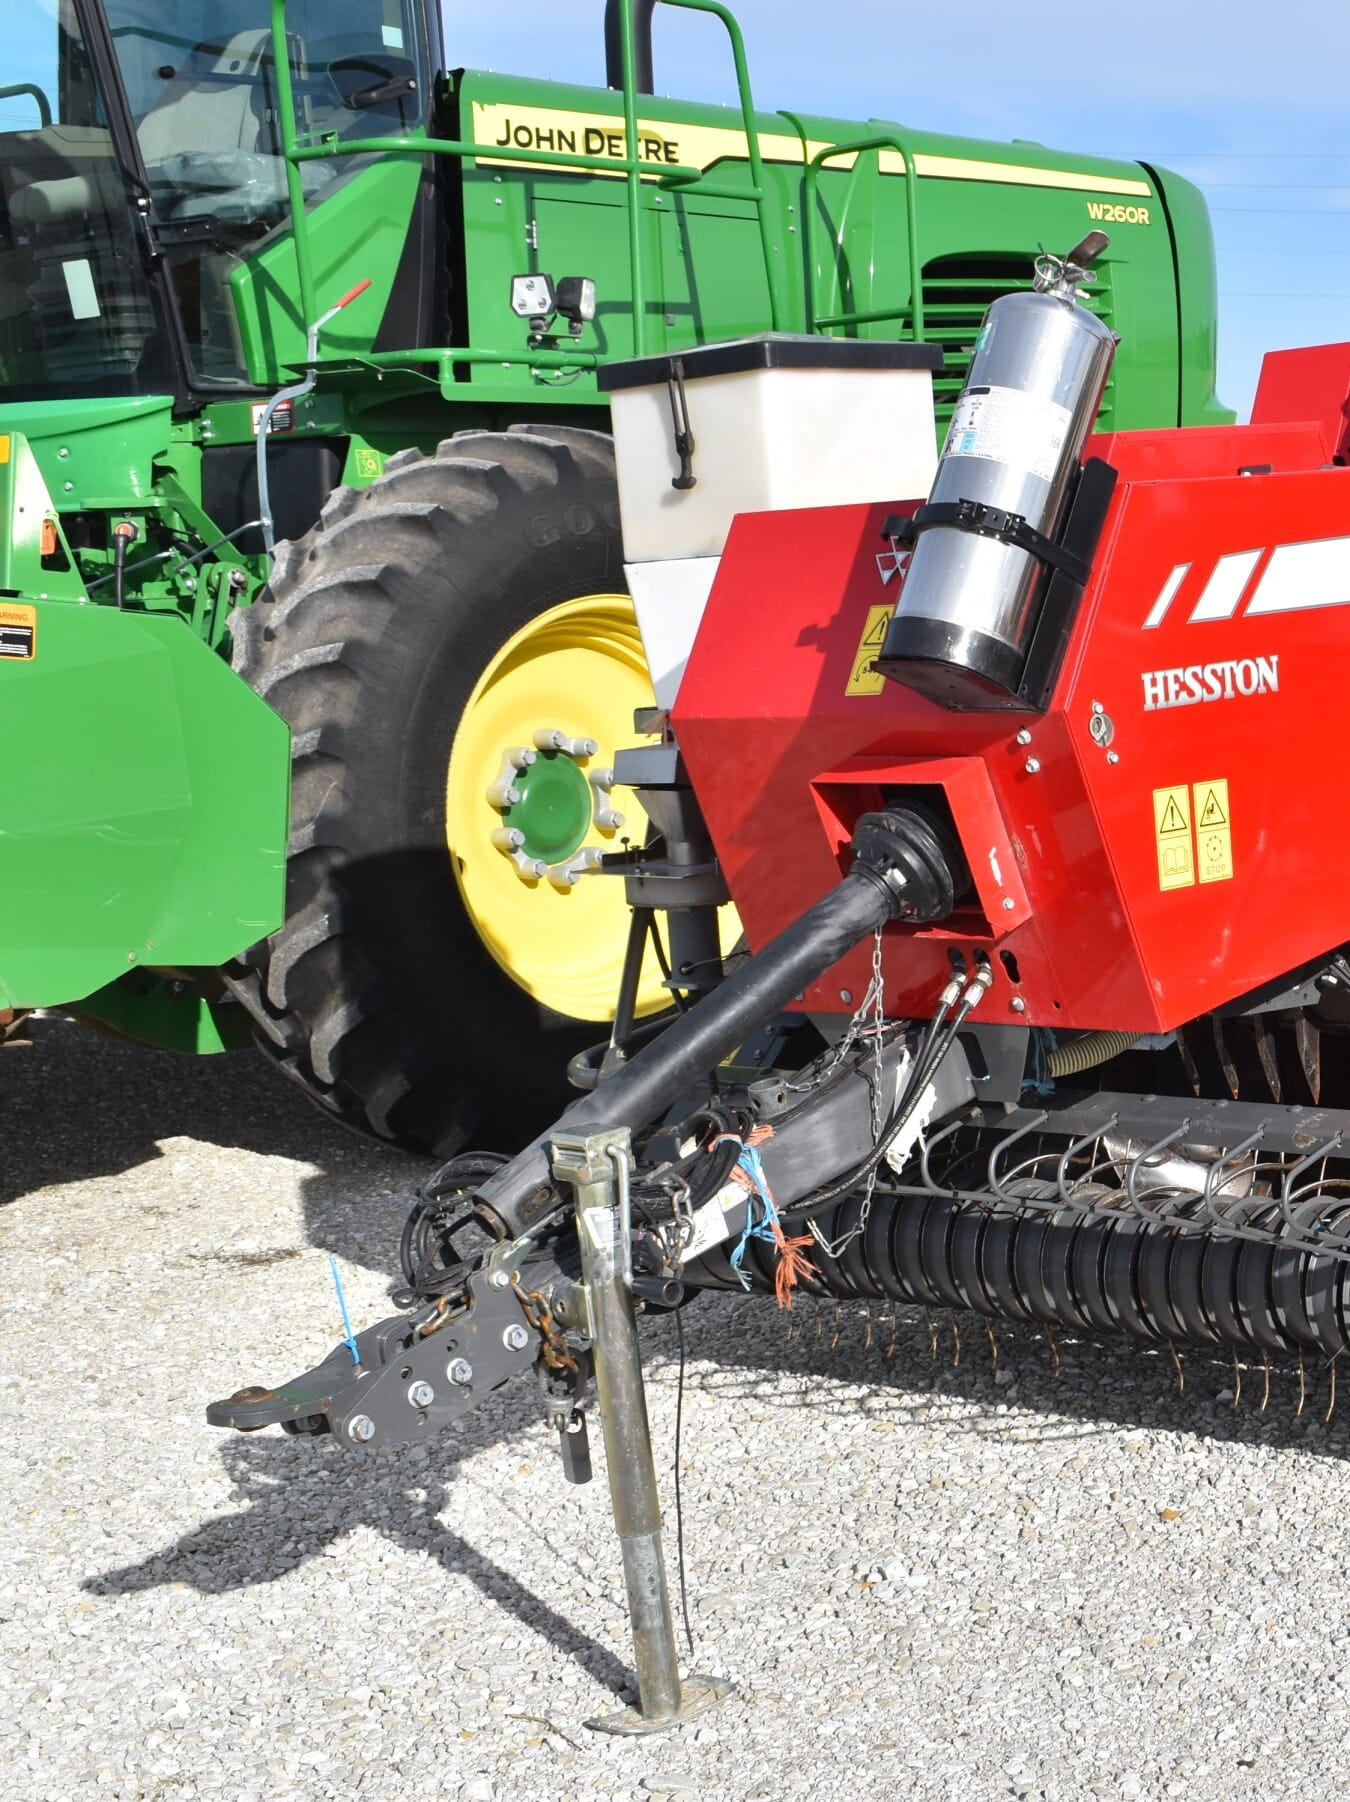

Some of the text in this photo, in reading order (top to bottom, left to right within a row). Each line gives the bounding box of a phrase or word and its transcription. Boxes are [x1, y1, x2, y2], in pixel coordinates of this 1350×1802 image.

[496, 119, 680, 164] JOHN DERE
[1086, 202, 1151, 226] W260R
[1141, 655, 1279, 711] HESSTON
